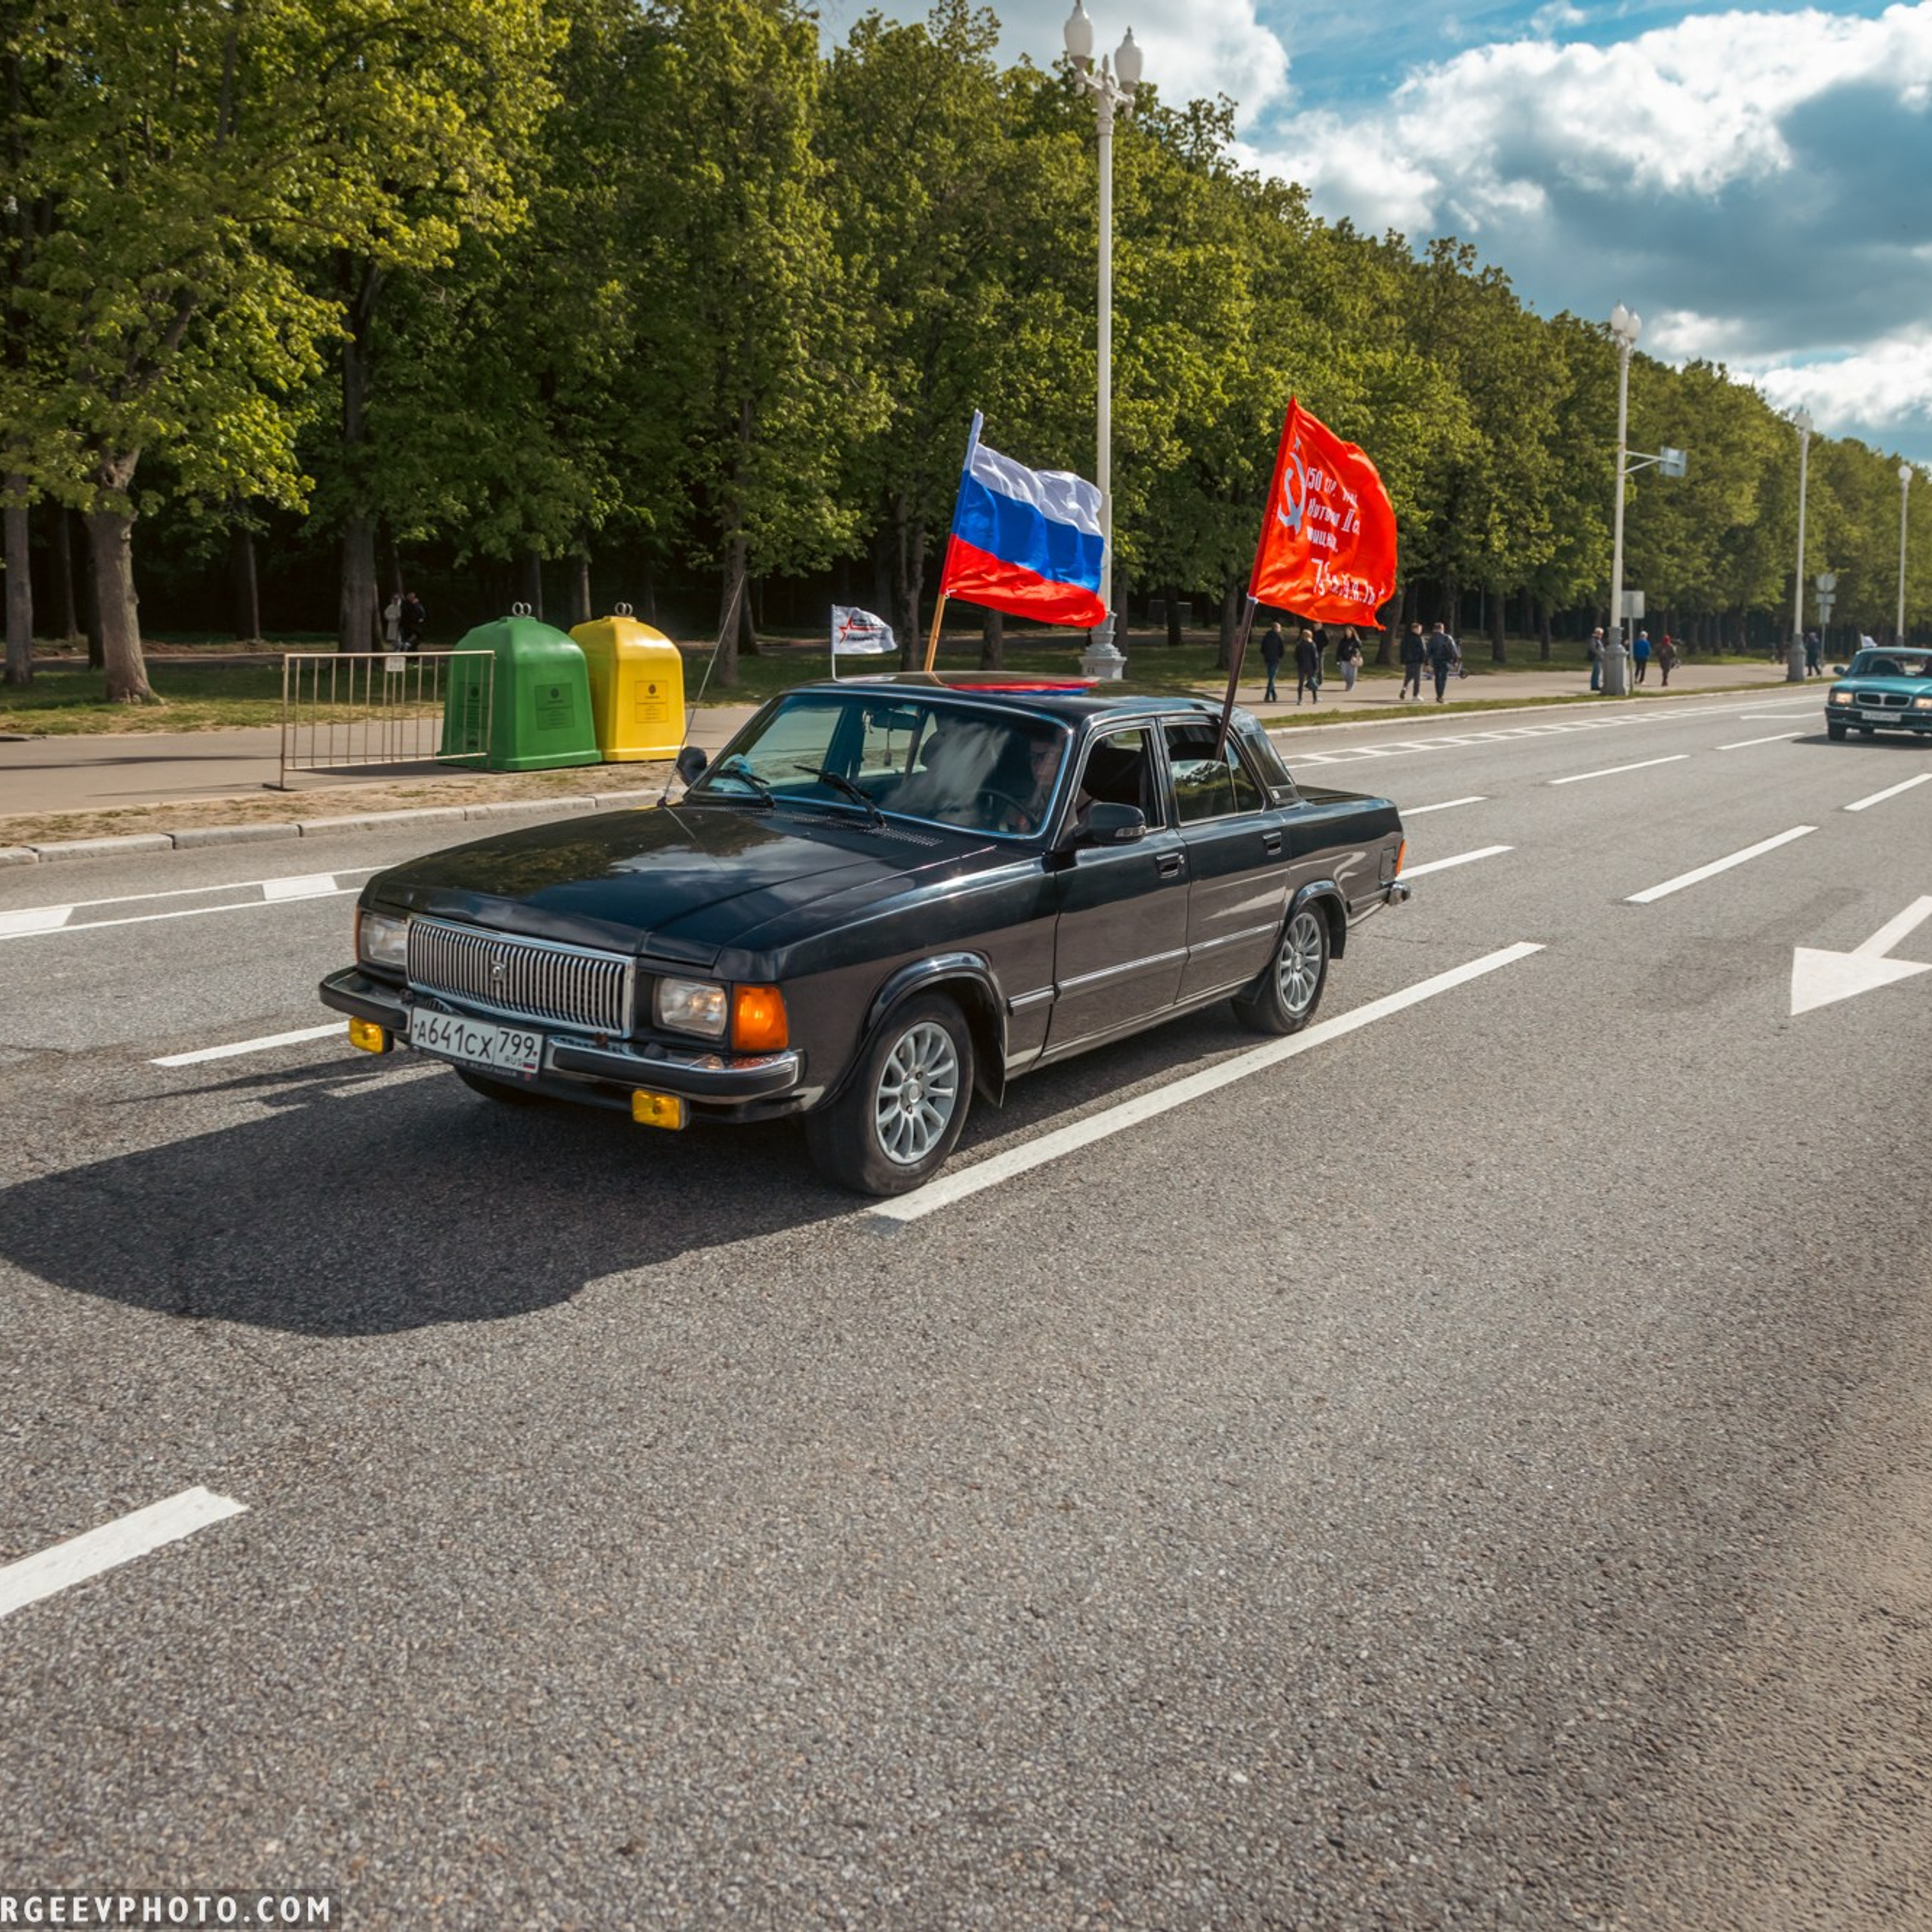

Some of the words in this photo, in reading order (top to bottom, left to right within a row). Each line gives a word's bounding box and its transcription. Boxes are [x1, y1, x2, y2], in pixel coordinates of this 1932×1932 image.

[417, 1018, 494, 1059] А641СХ
[499, 1031, 535, 1057] 799
[504, 1056, 522, 1067] RUS
